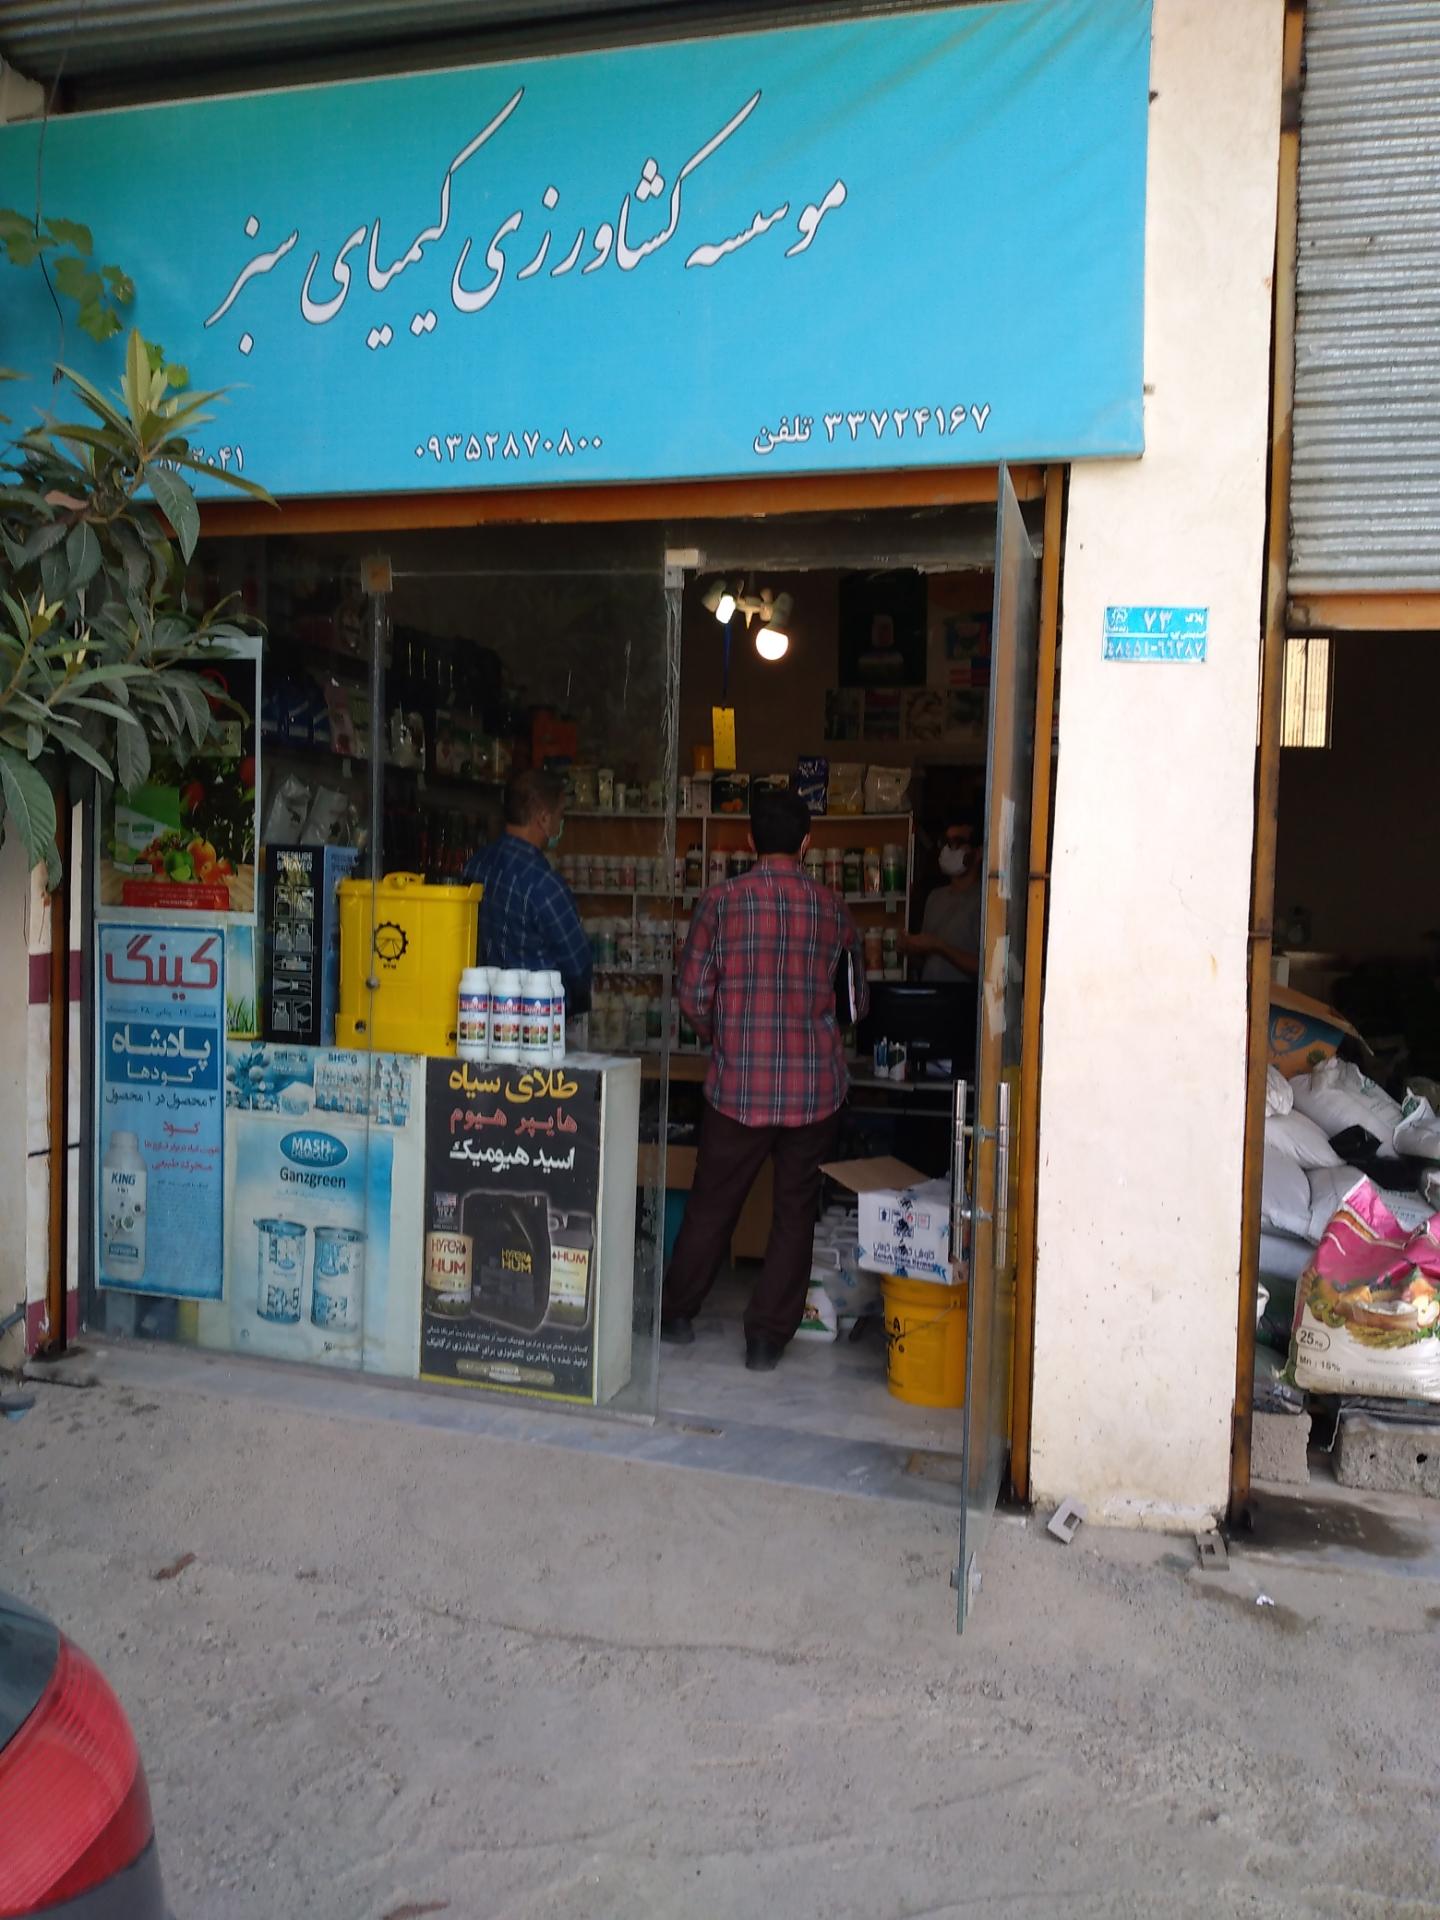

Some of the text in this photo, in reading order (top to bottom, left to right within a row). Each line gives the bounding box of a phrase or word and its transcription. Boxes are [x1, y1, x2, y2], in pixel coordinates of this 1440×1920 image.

[202, 85, 848, 355] موسسه کشاورزی کیمیای سبز
[752, 402, 991, 455] ۳۳۷۲۴۱۶۷ تلفن
[414, 429, 604, 464] ۰۹۳۵۲۸۷۰۸۰۰
[276, 860, 313, 872] SPRAYER
[105, 934, 219, 1001] کینگ
[112, 1024, 211, 1072] پادشاه
[127, 1061, 197, 1087] کودها
[449, 1062, 578, 1103] طلای سیاه
[105, 1087, 144, 1105] محصول
[166, 1091, 208, 1109] محصول
[163, 1121, 200, 1137] کود
[450, 1106, 578, 1137] هایپر هیوم
[291, 1136, 332, 1154] MASH
[450, 1139, 576, 1174] اسید هیومیک
[111, 1171, 136, 1186] KING
[280, 1166, 346, 1189] Ganzgreen
[431, 1258, 466, 1275] HUM
[502, 1259, 532, 1275] HUM
[557, 1253, 587, 1265] HUM
[1300, 1330, 1314, 1345] 25
[558, 1357, 572, 1365] شده
[573, 1358, 588, 1368] تولید
